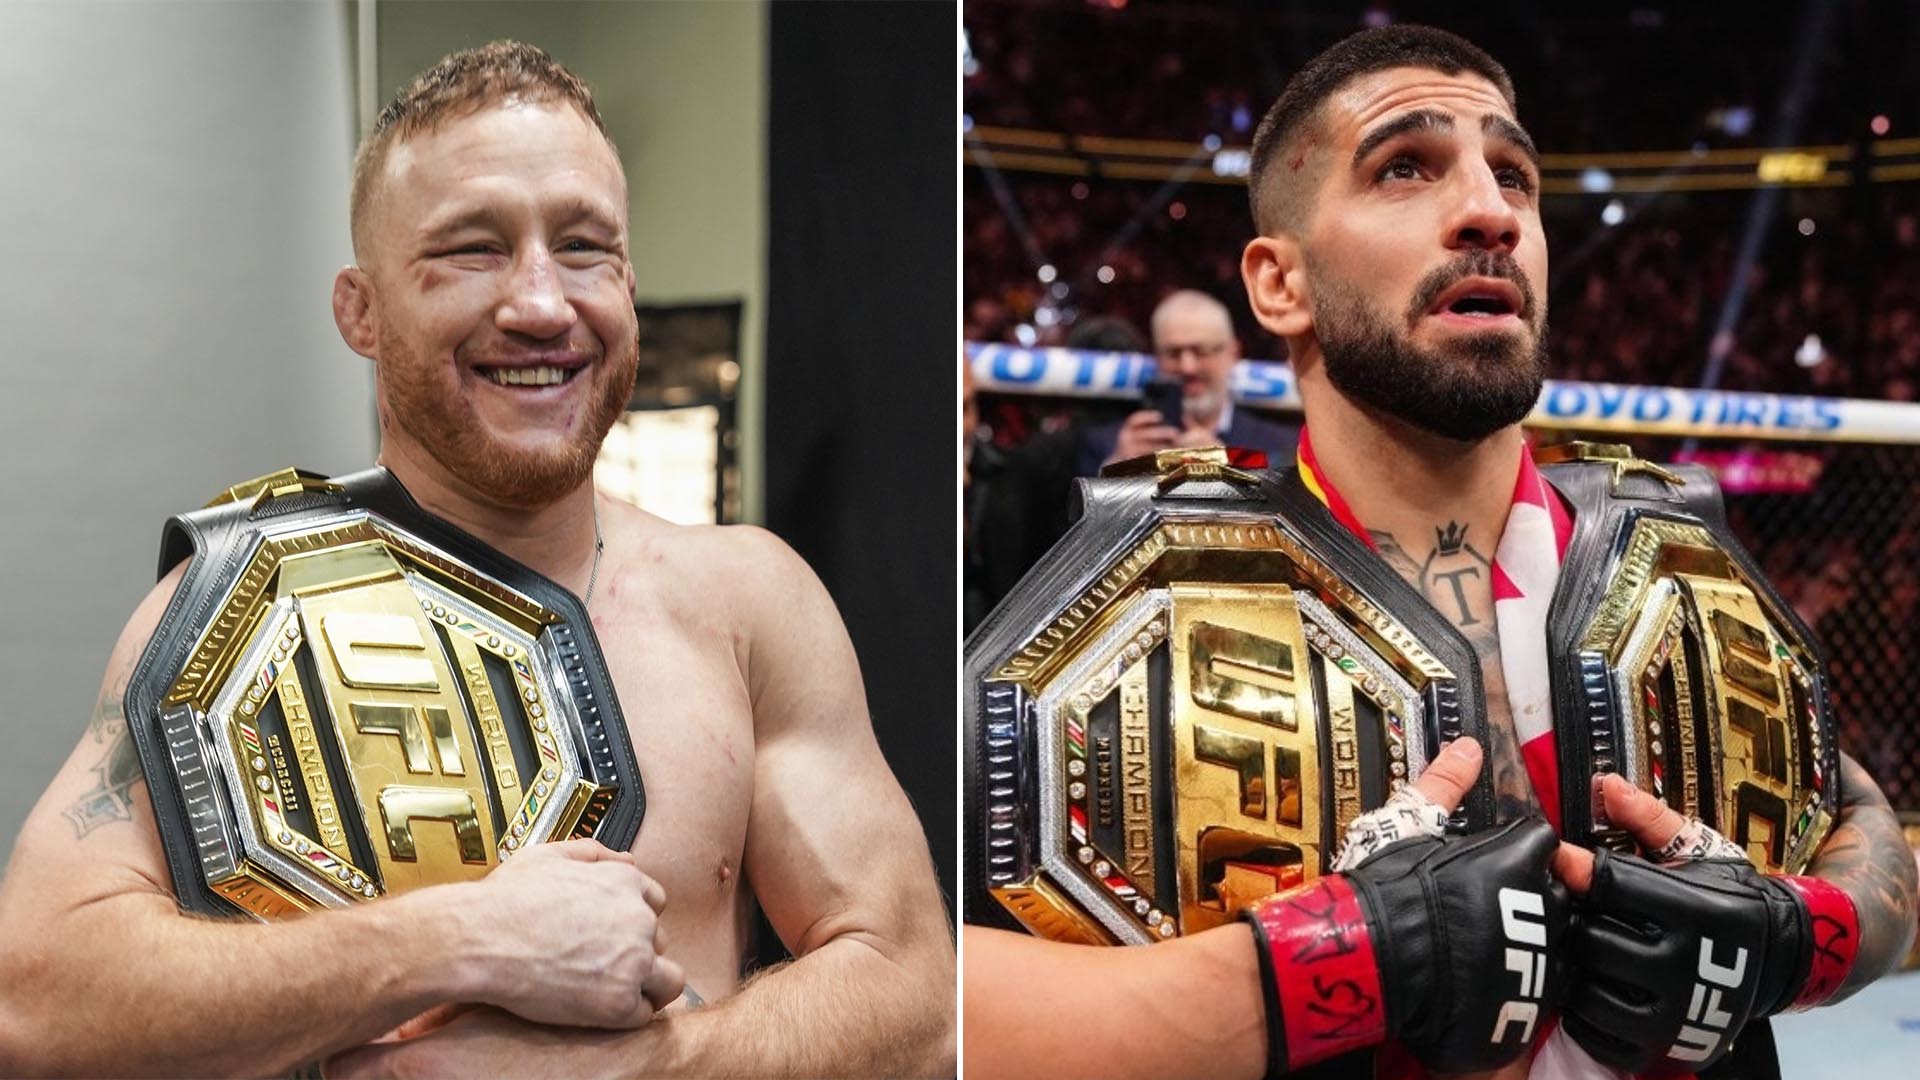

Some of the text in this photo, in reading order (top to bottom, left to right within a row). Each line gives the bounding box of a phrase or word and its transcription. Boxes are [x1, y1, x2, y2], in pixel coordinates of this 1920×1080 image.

[1546, 382, 1841, 430] OYO TIRES
[281, 679, 343, 848] CHAMPION
[320, 611, 488, 865] UFC
[466, 663, 517, 788] WORLD
[1126, 682, 1150, 877] CHAMPION
[1188, 620, 1304, 912] UFC
[1334, 706, 1357, 820] WORL
[1708, 608, 1788, 868] UFC
[1379, 819, 1400, 841] UF
[1490, 887, 1547, 1044] UFC
[1667, 936, 1748, 1062] UFC
